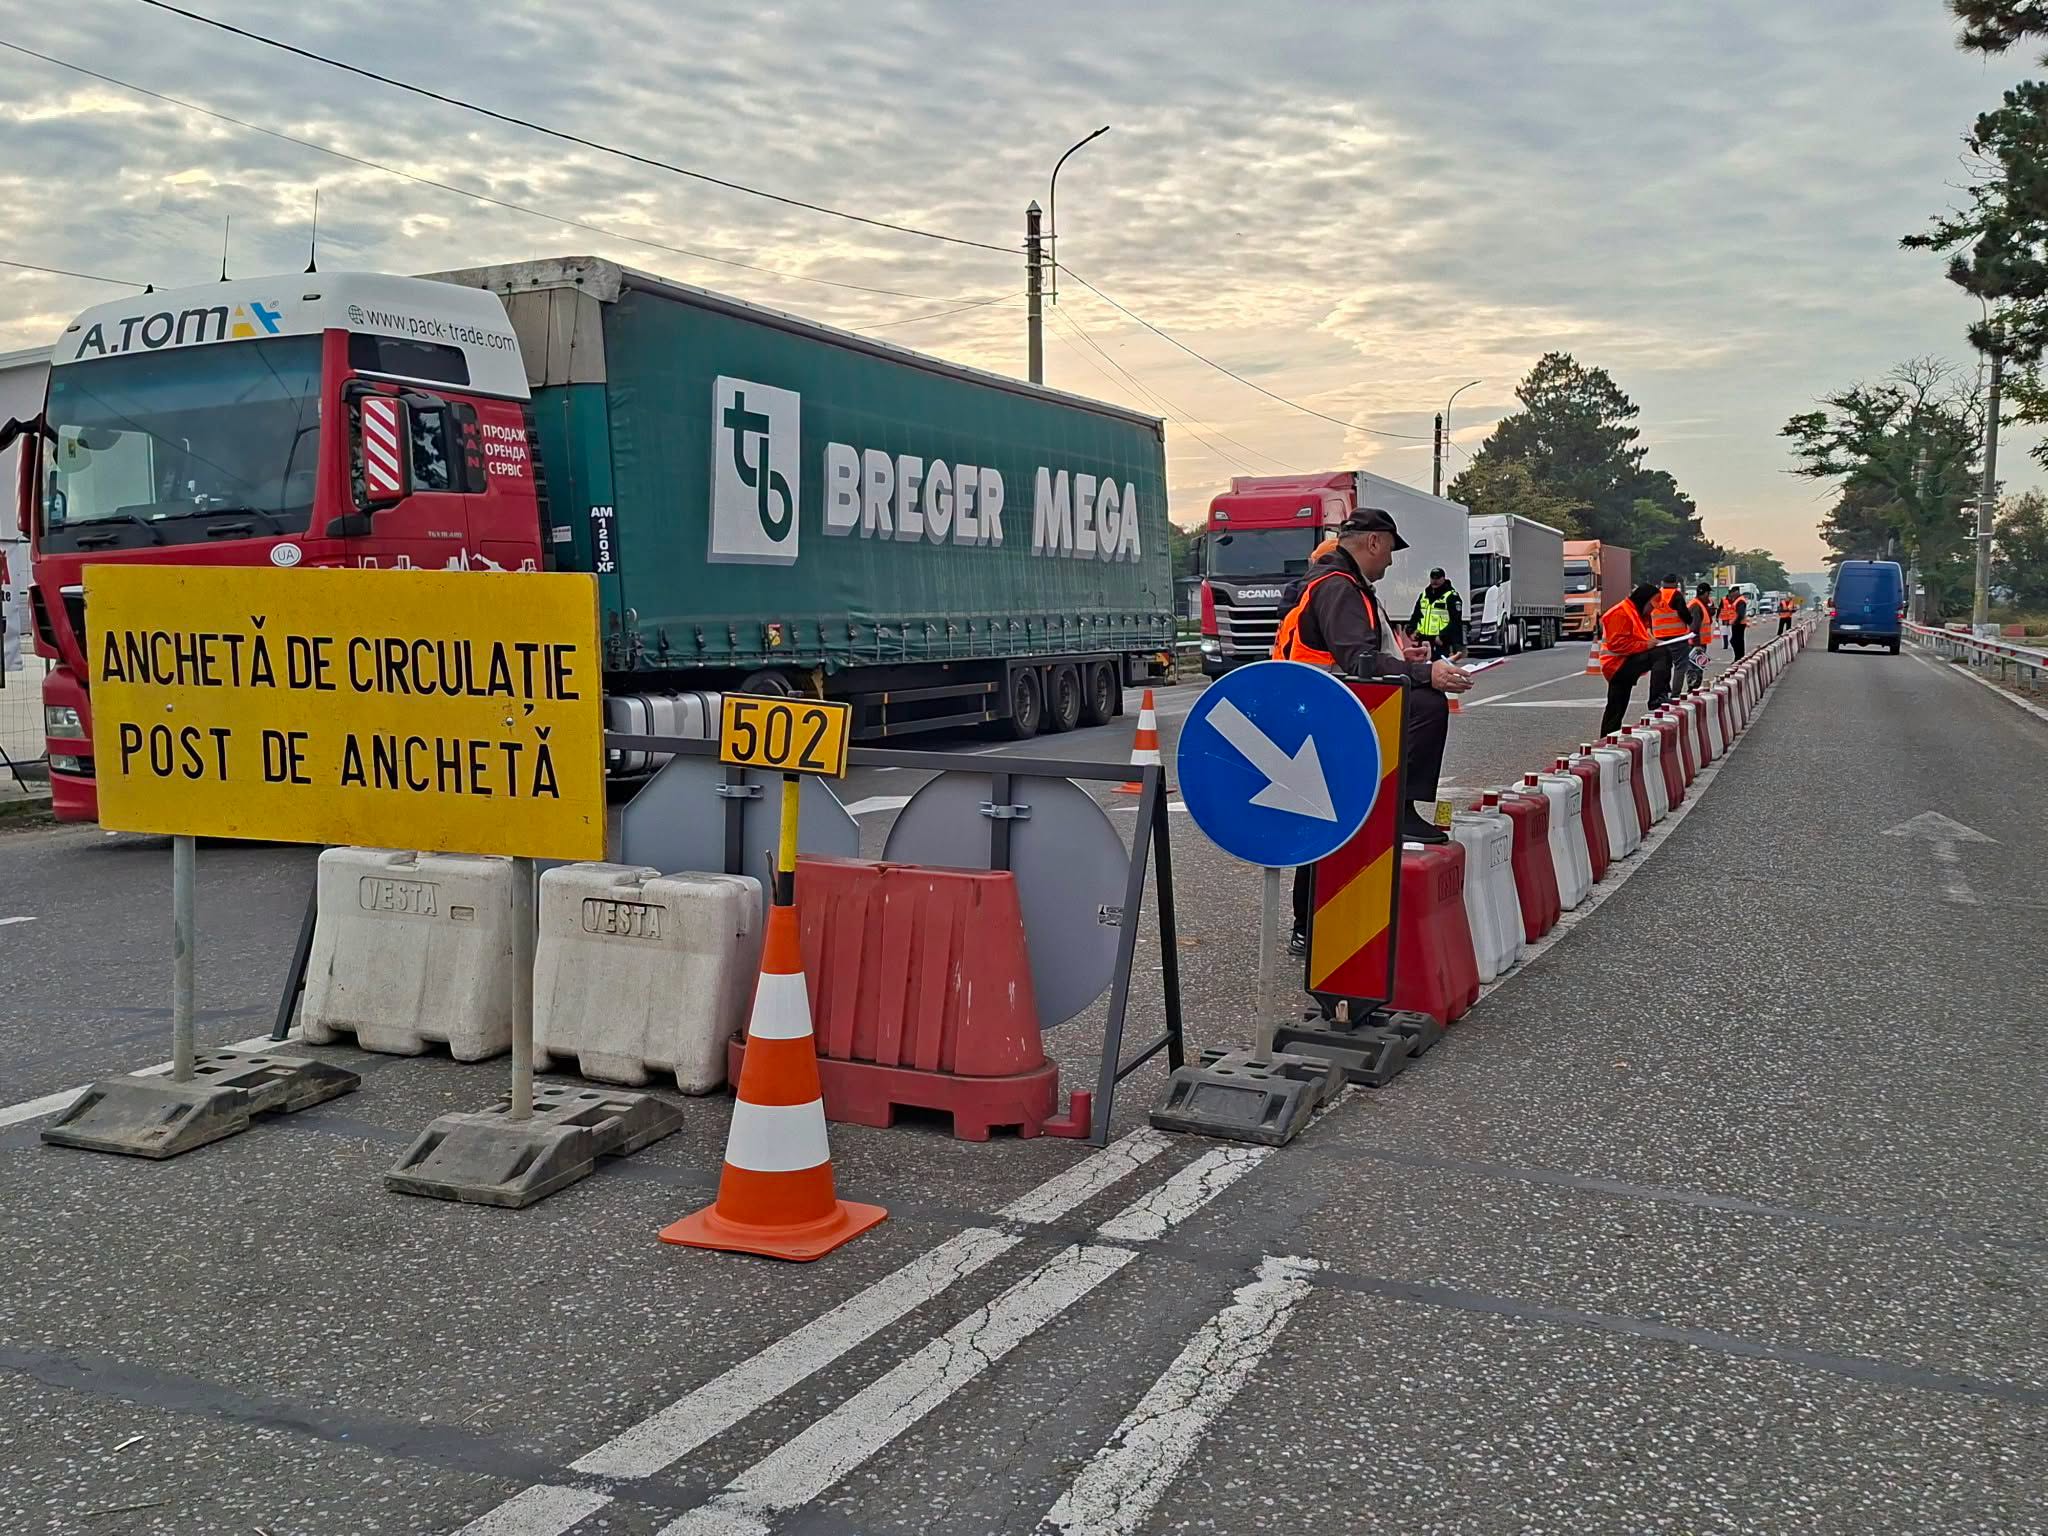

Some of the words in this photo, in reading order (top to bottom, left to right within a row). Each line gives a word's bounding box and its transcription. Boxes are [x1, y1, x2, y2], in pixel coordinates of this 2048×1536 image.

[462, 423, 481, 469] MAN
[482, 424, 527, 443] ПРОДАЖ
[484, 442, 527, 462] ОРЕНДА
[488, 461, 524, 478] СЕРВІС
[822, 441, 1005, 546] BREGER
[1031, 466, 1142, 563] MEGA
[277, 549, 295, 561] UA
[1237, 589, 1283, 599] SCANIA
[102, 614, 277, 689] ANCHETĂ
[286, 635, 337, 691] DE
[348, 636, 580, 717] CIRCULAȚIE
[731, 701, 828, 770] 502
[119, 722, 232, 782] POST
[261, 729, 312, 785] DE
[340, 725, 560, 800] ANCHETĂ
[369, 878, 438, 915] VESTA
[585, 899, 663, 938] VESTA
